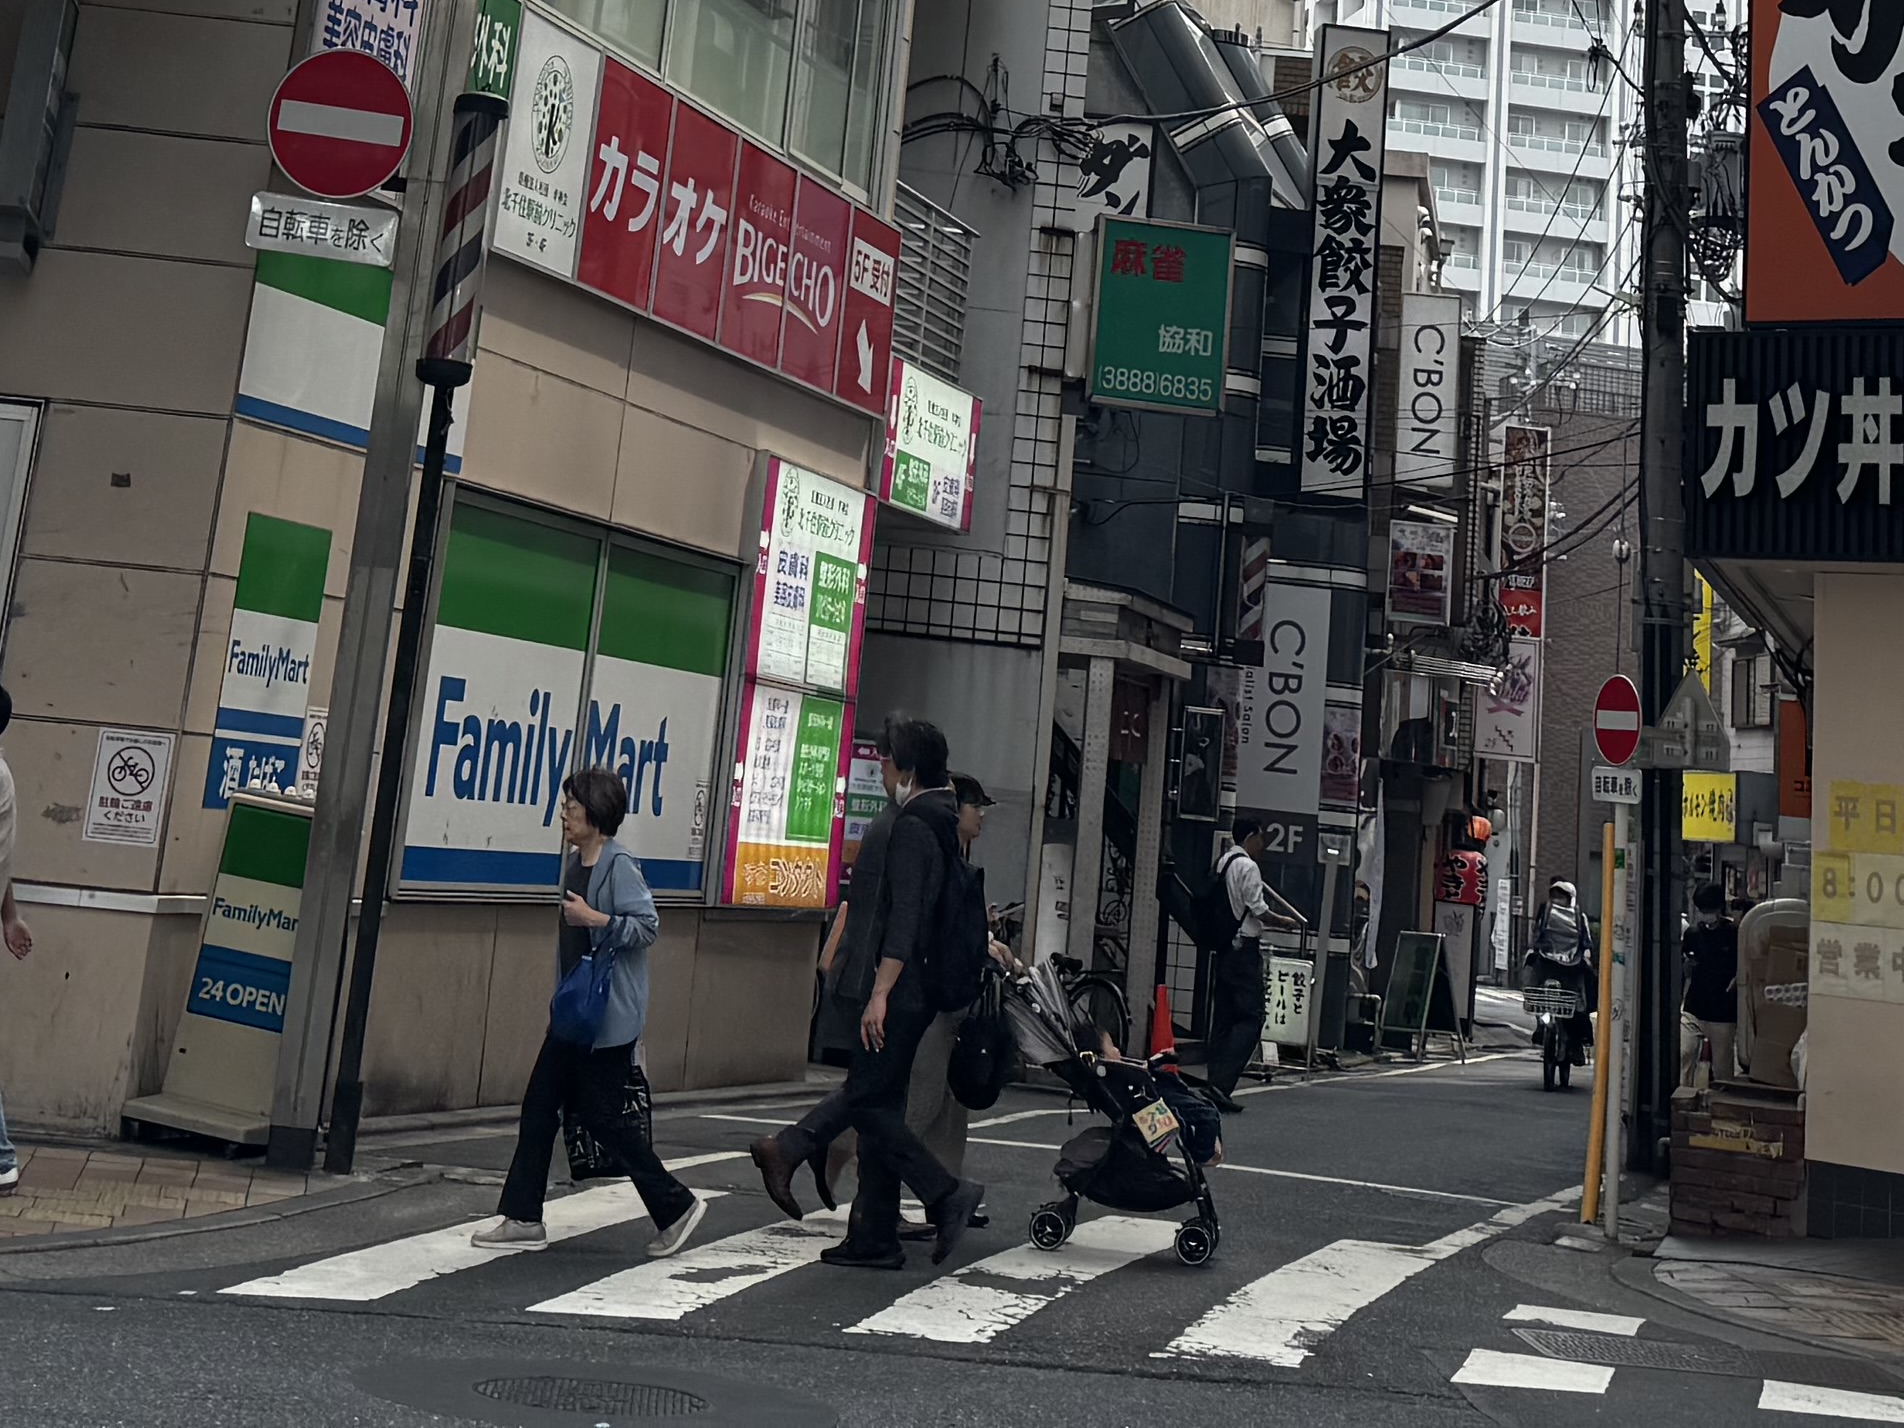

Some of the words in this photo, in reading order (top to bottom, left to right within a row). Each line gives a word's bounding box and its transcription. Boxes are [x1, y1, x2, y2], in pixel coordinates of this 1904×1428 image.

[471, 11, 512, 89] 外科
[1770, 86, 1874, 252] とんかつ
[590, 135, 727, 265] カラオケ
[258, 207, 384, 255] 自転車を除く
[1111, 237, 1187, 283] 麻雀
[1305, 121, 1378, 477] 大衆餃子酒場
[1159, 324, 1213, 357] 協和
[1098, 365, 1213, 402] (3888)6835
[1703, 376, 1904, 505] カツ丼
[228, 639, 310, 688] FamilyMart
[1263, 619, 1306, 778] C'BON
[424, 674, 669, 826] FamilyMart
[1266, 825, 1304, 852] 2F
[1833, 795, 1897, 835] 平日
[212, 897, 299, 932] FamilyMar
[226, 983, 286, 1017] OPEN
